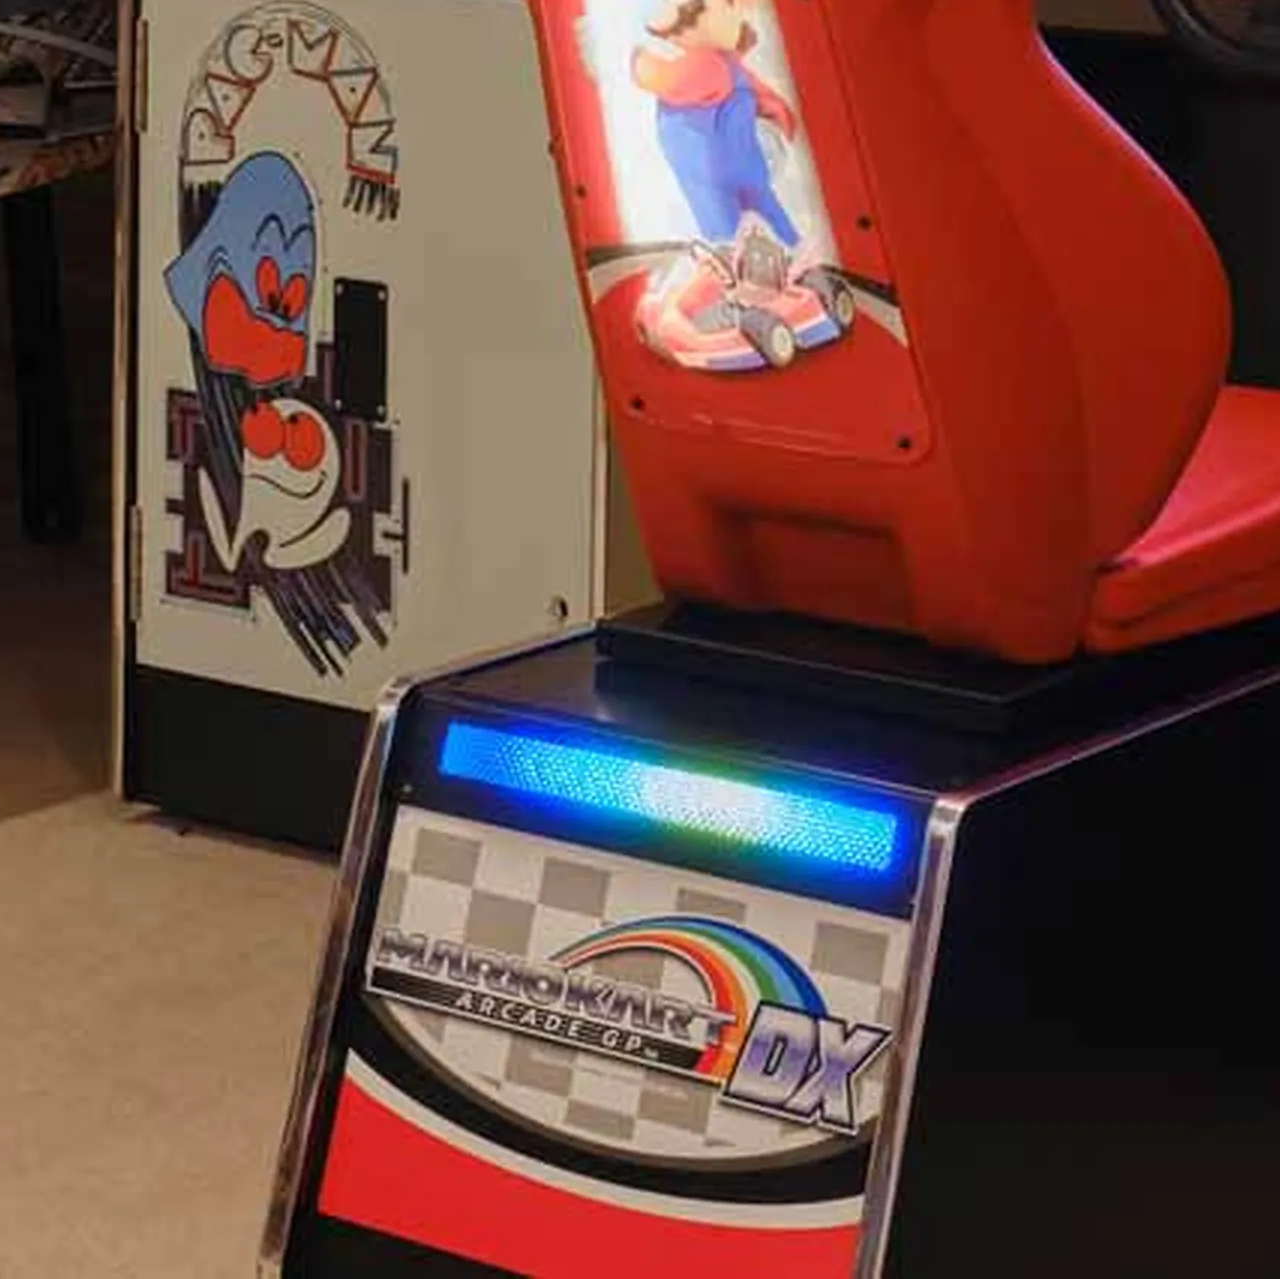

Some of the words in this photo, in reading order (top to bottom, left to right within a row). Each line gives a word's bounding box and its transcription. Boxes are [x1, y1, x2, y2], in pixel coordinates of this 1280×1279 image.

[179, 16, 398, 186] PAC-MAN
[454, 992, 582, 1040] ARCADE
[600, 1027, 642, 1054] GP
[726, 1004, 892, 1130] DX
